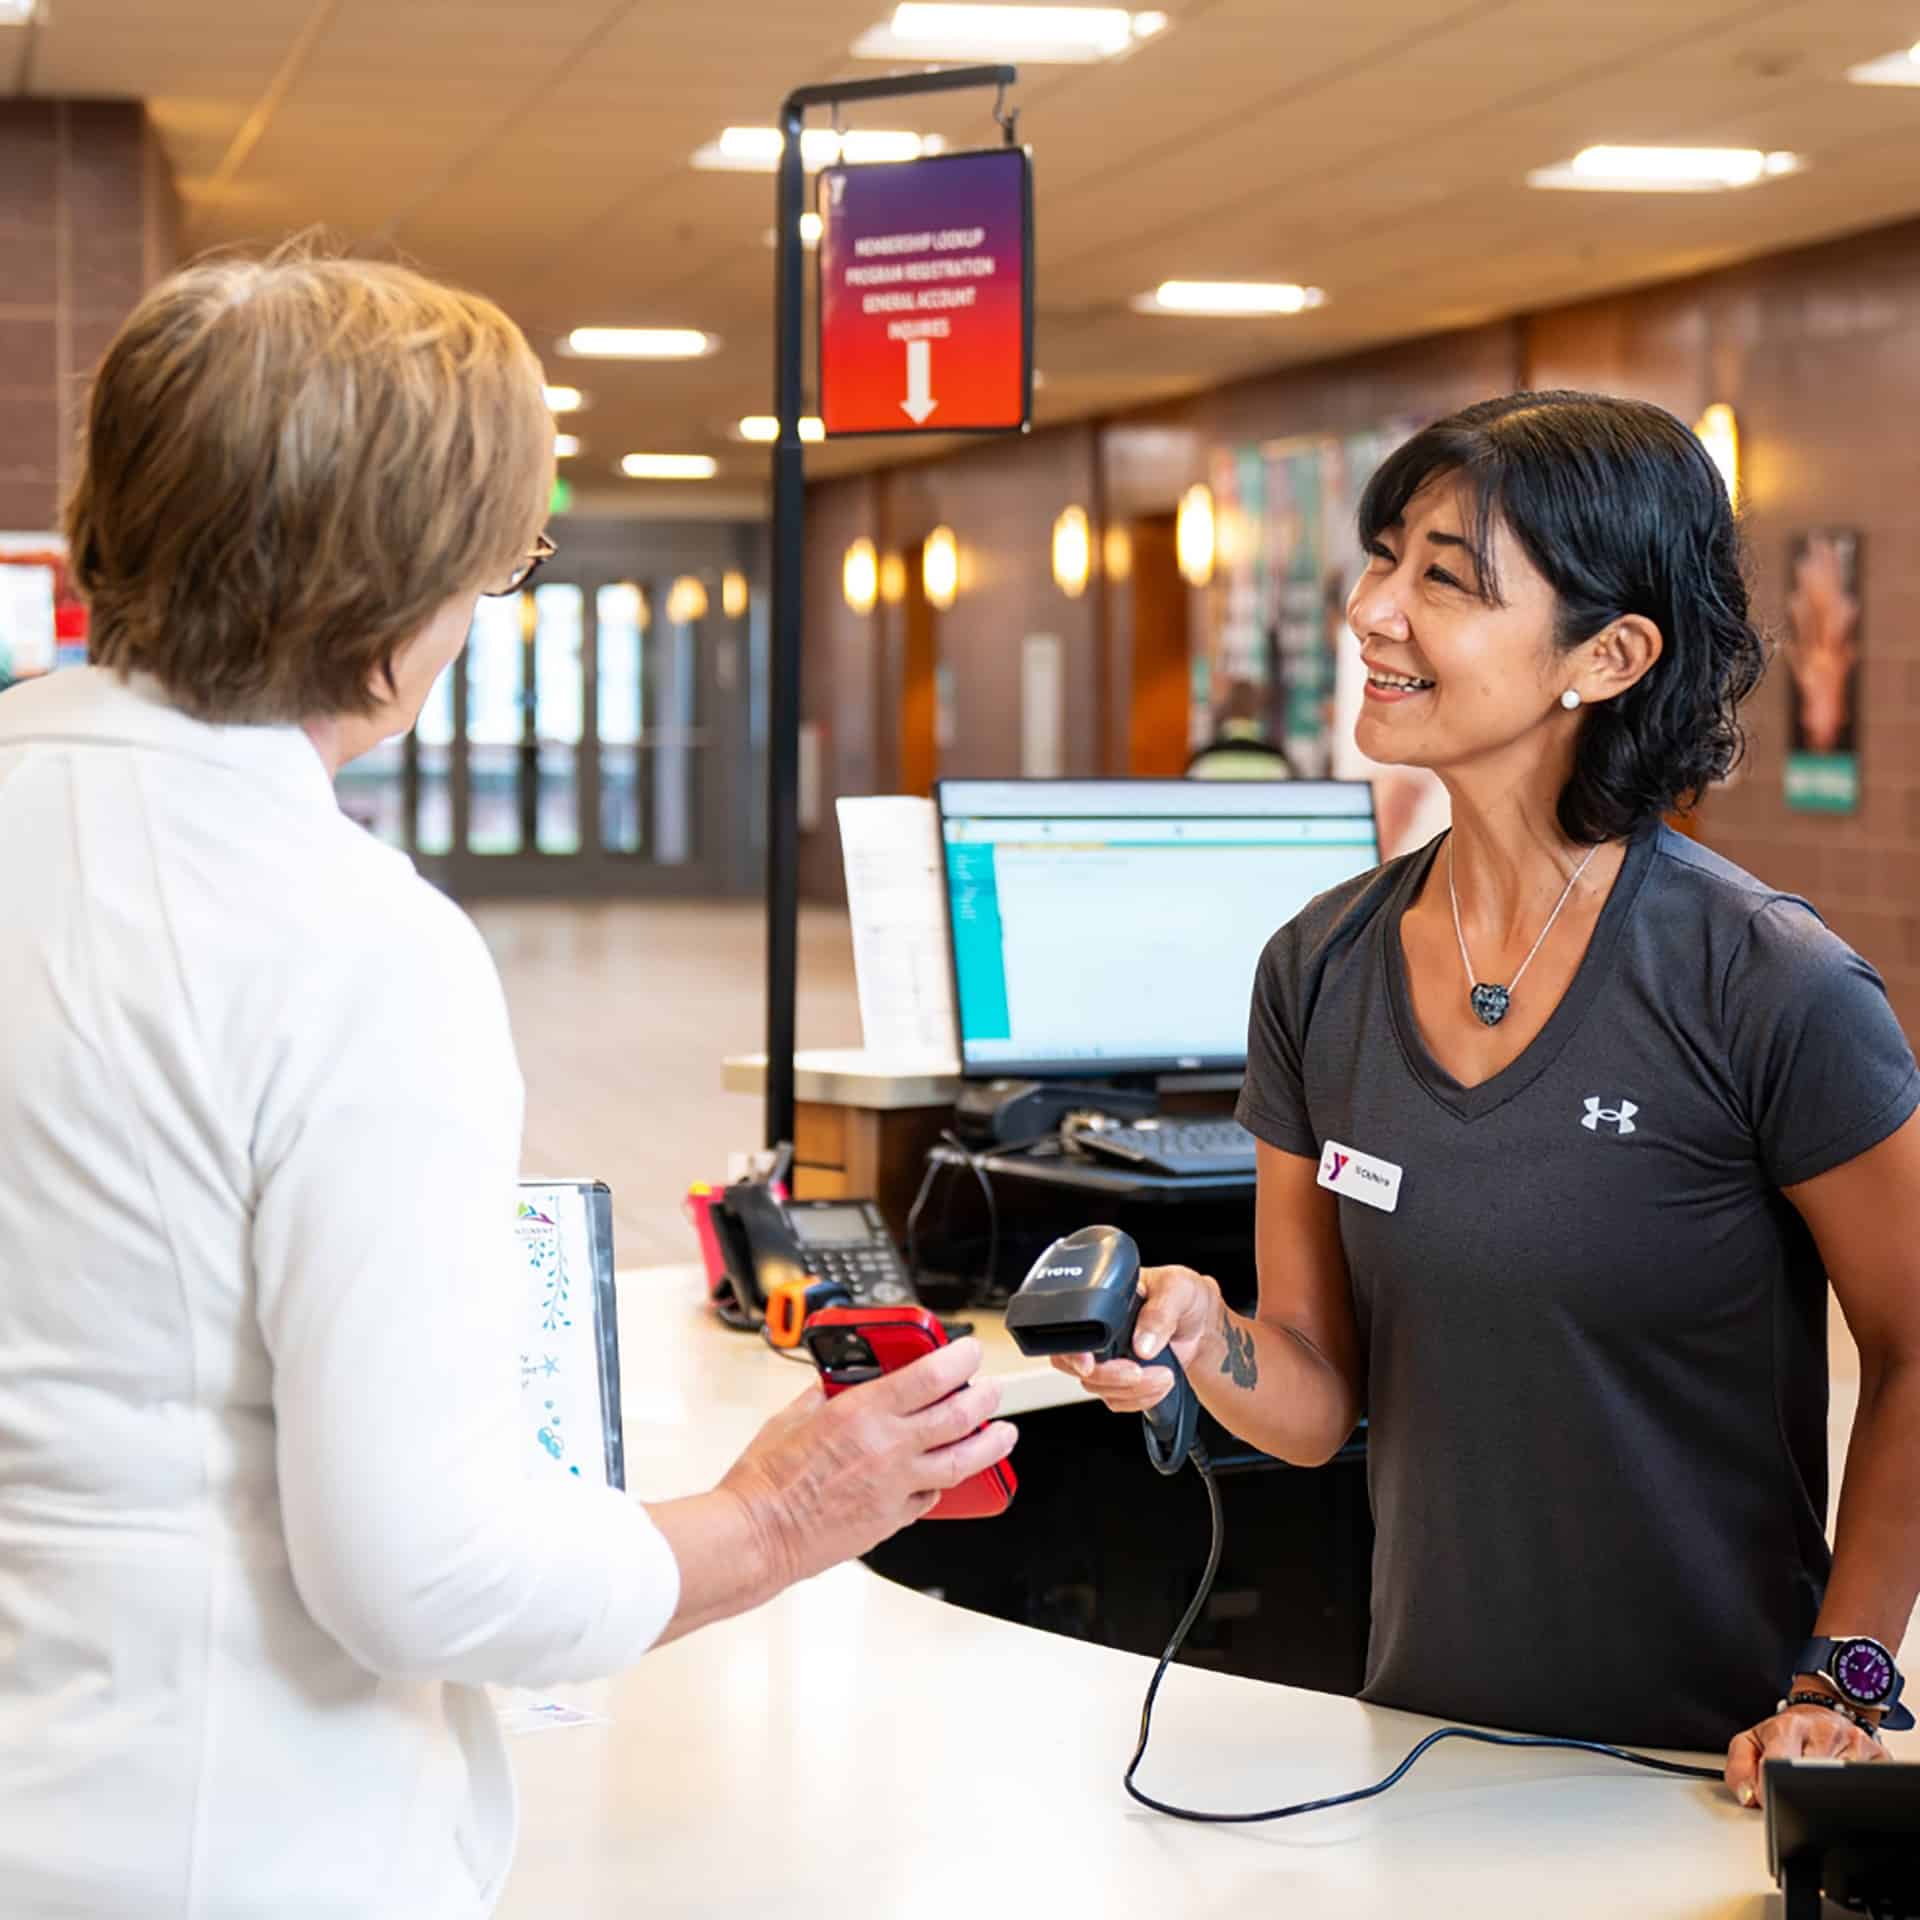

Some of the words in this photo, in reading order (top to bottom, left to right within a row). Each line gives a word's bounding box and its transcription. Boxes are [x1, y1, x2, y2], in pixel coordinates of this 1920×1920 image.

[855, 232, 931, 256] MEMBERSHIP
[932, 227, 985, 250] LOOKUP
[845, 265, 902, 285] PROGRAM
[903, 257, 995, 281] REGISTRATION
[862, 292, 915, 314] GENERAL
[916, 286, 976, 309] ACCOUNT
